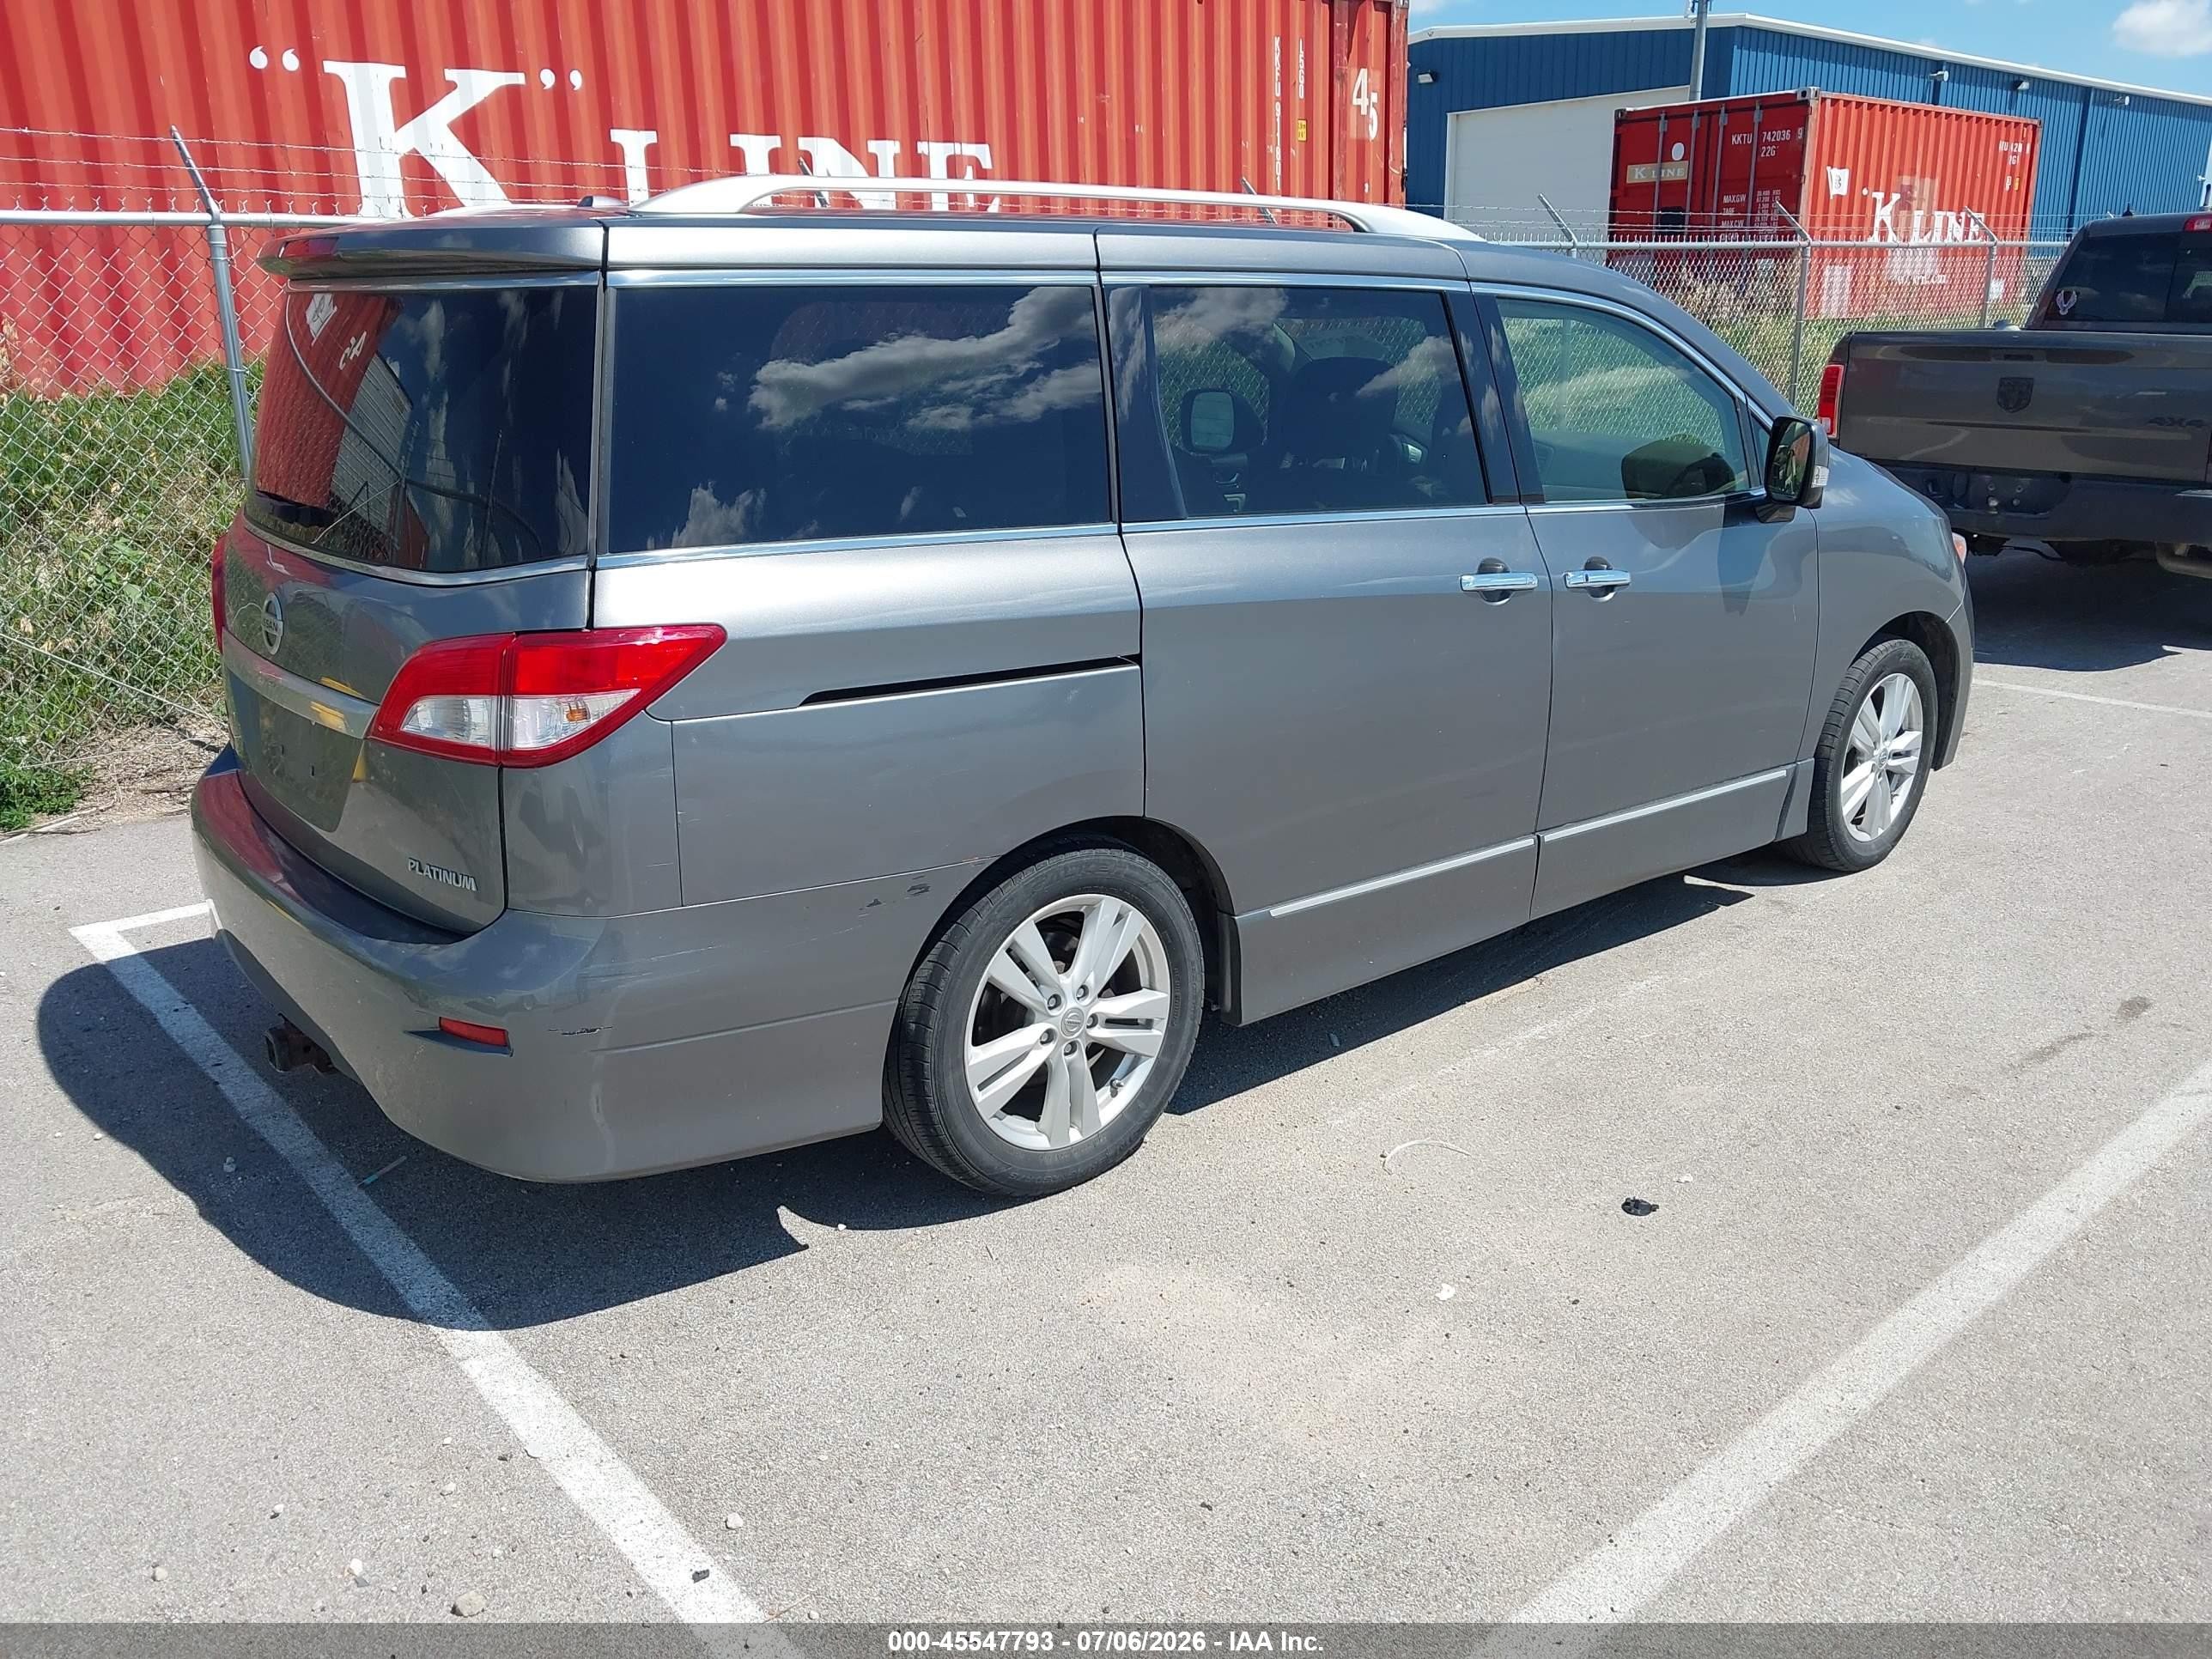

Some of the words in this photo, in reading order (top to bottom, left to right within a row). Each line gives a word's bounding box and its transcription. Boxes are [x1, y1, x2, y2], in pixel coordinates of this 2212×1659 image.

[1731, 132, 1753, 145] KKTU
[1762, 129, 1791, 143] 742036
[1760, 145, 1780, 158] 22G
[1651, 167, 1686, 179] LINE
[1911, 210, 1985, 243] LINE
[408, 857, 478, 892] PLATINUM
